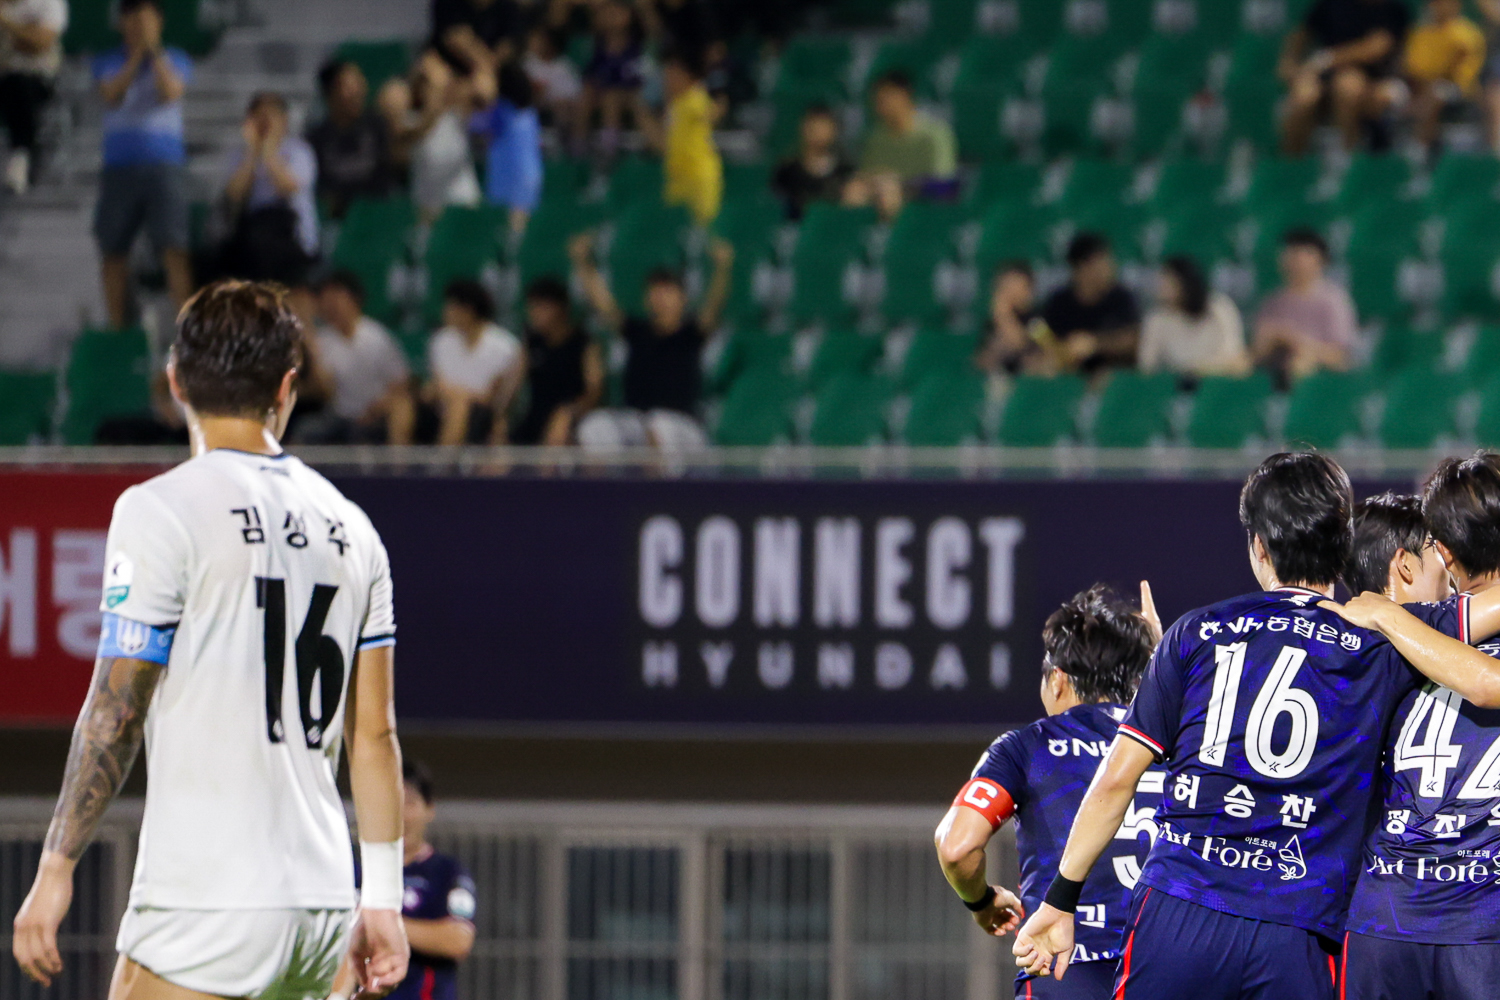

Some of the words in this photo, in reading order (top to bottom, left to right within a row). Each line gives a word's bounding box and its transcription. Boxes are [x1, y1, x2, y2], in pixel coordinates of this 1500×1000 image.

[638, 514, 1025, 629] CONNECT
[255, 576, 345, 749] 16
[641, 641, 1011, 690] HYUNDAI
[1198, 641, 1320, 780] 16
[963, 780, 998, 809] C
[1173, 773, 1318, 829] 허승찬
